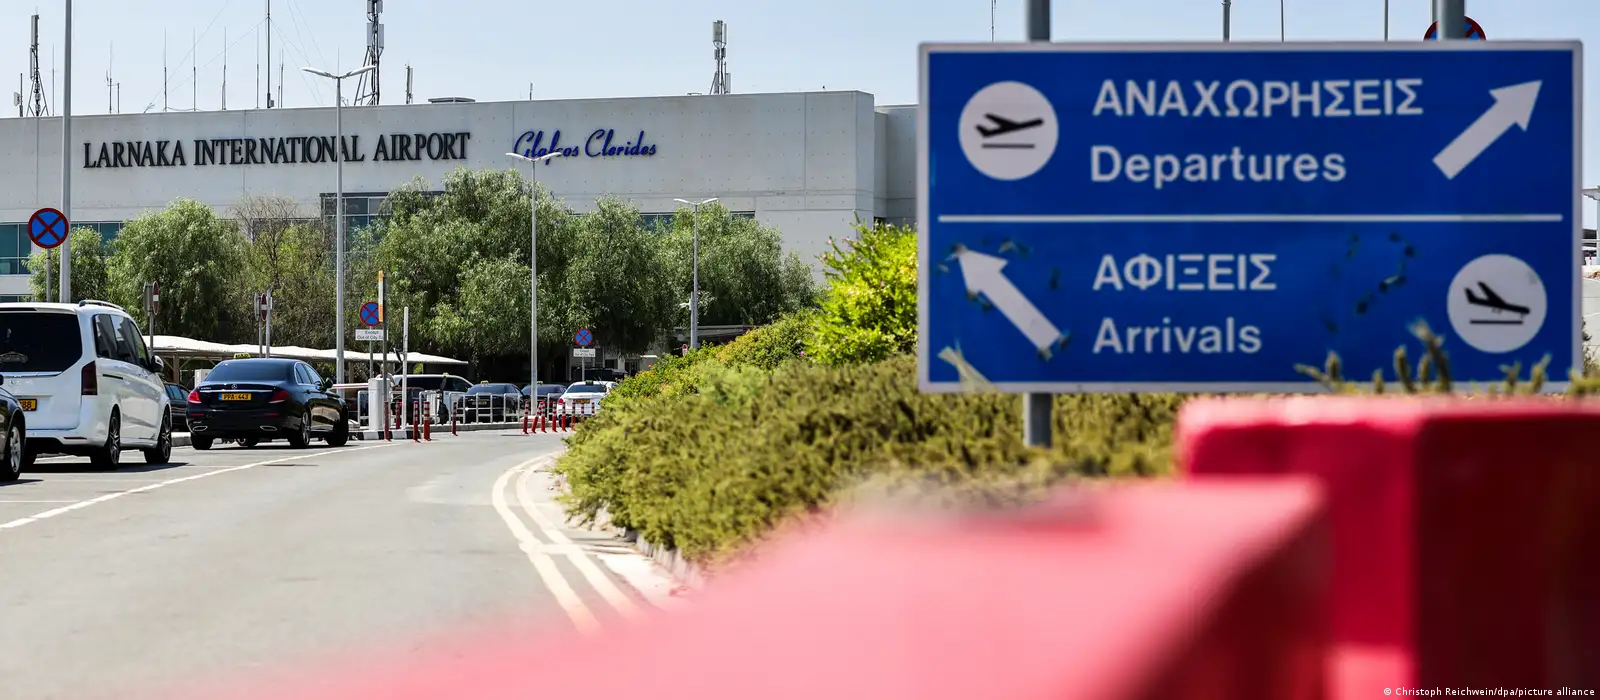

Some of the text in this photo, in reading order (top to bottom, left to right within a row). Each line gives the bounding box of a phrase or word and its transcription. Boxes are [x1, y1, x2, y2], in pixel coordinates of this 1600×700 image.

[1092, 78, 1424, 118] ΑΝΑΧΩΡΗΣΕΙΣ
[83, 132, 471, 169] LARNAKA INTERNATIONAL AIRPORT
[584, 128, 657, 158] Clerides
[1090, 145, 1348, 190] Departures
[1092, 253, 1277, 292] ΑΦΙΞΕΙΣ
[1092, 316, 1262, 354] Arrivals
